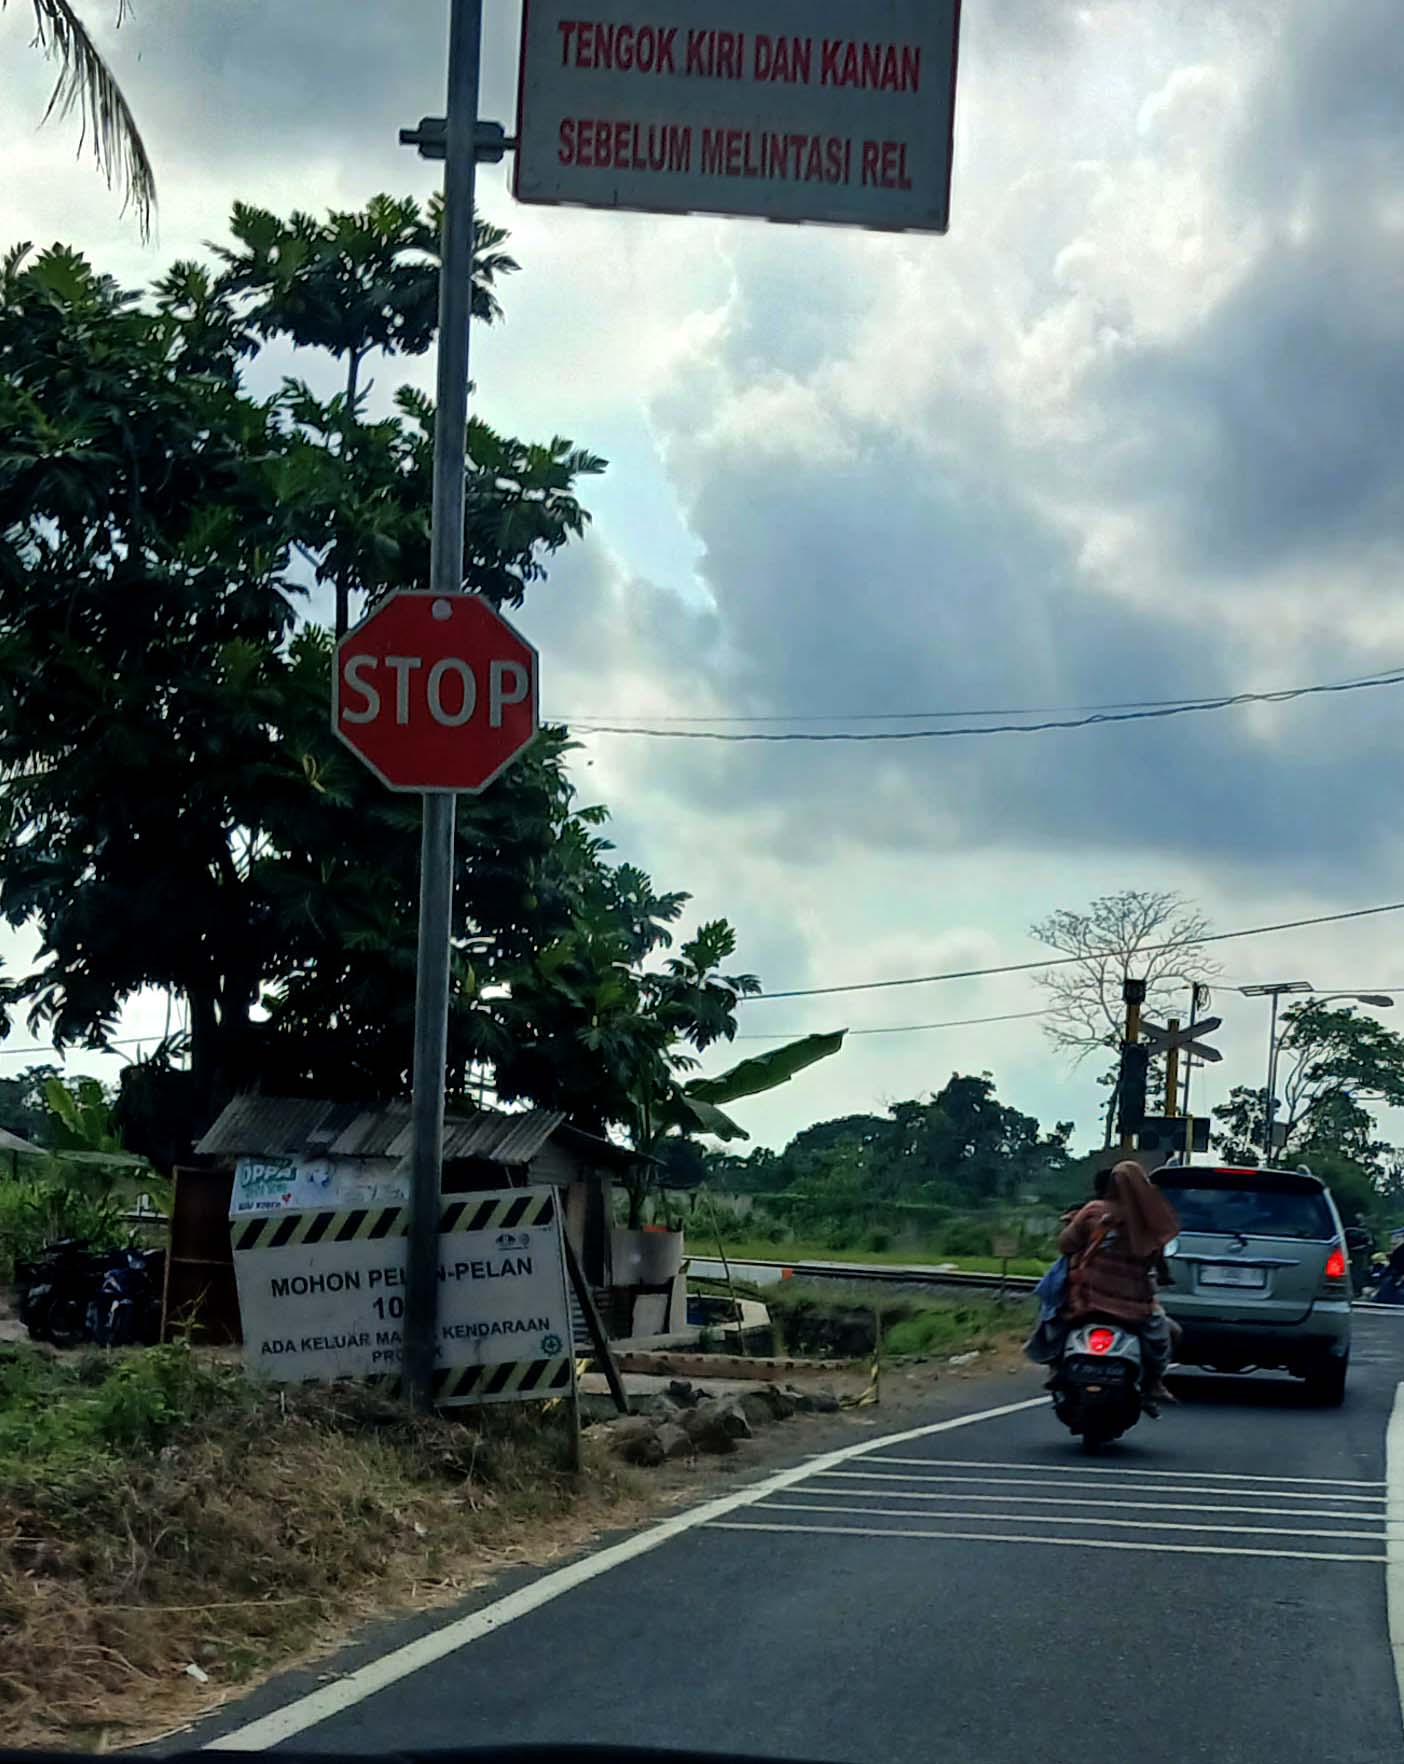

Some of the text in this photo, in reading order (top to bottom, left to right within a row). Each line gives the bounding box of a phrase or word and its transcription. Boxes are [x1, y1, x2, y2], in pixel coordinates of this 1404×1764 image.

[558, 20, 921, 93] TENGOK KIRI DAN KANAN
[558, 116, 914, 190] SEBELUM MELINTASI REL
[342, 653, 529, 728] STOP
[270, 1257, 532, 1297] MOHON PELN-PELAN
[372, 1296, 404, 1319] 10
[261, 1339, 297, 1355] ADA
[300, 1332, 370, 1351] KELUAR
[441, 1317, 550, 1339] KENDARAAN
